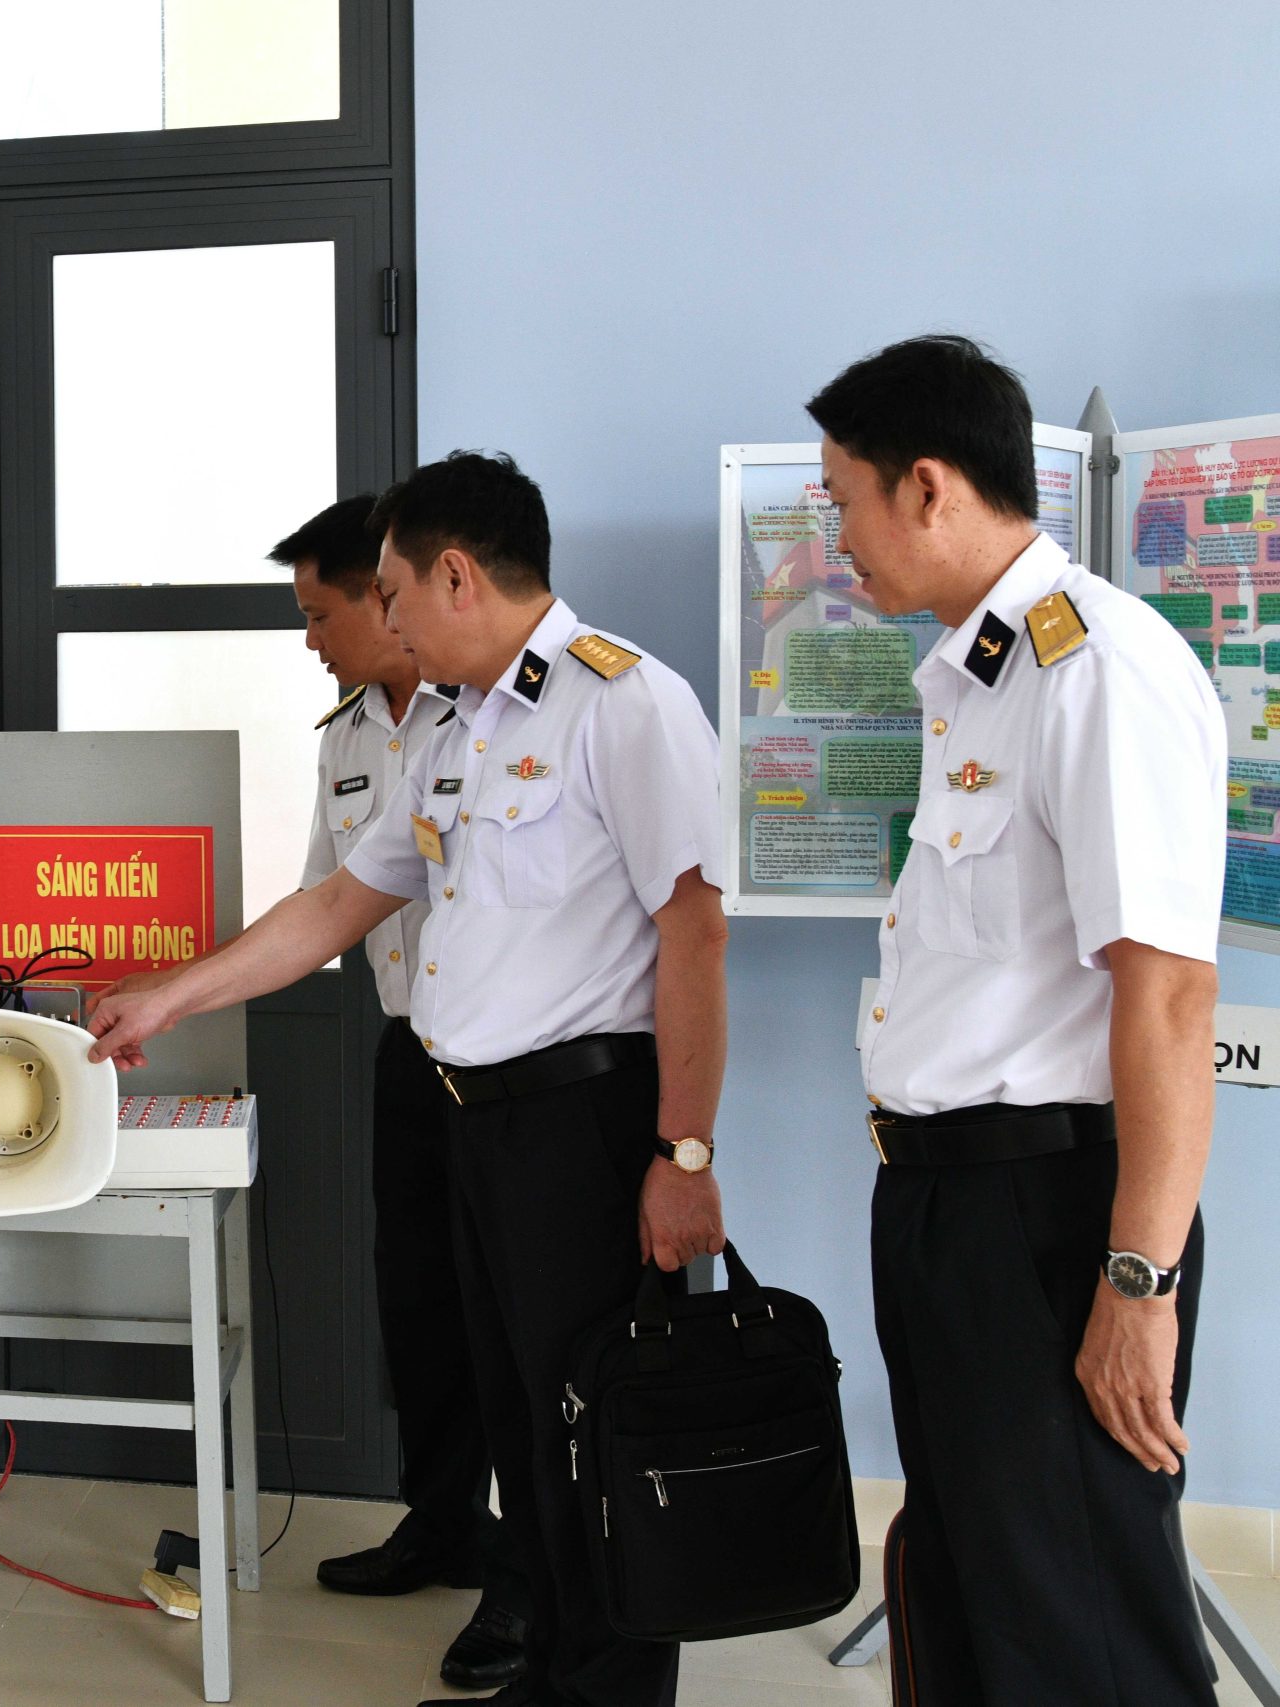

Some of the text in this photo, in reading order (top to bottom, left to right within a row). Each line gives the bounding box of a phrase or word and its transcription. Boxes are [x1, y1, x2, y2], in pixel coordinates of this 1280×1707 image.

[36, 851, 158, 897] SÁNG KIẾN
[2, 917, 195, 968] LOA NÉN DI ĐỘNG
